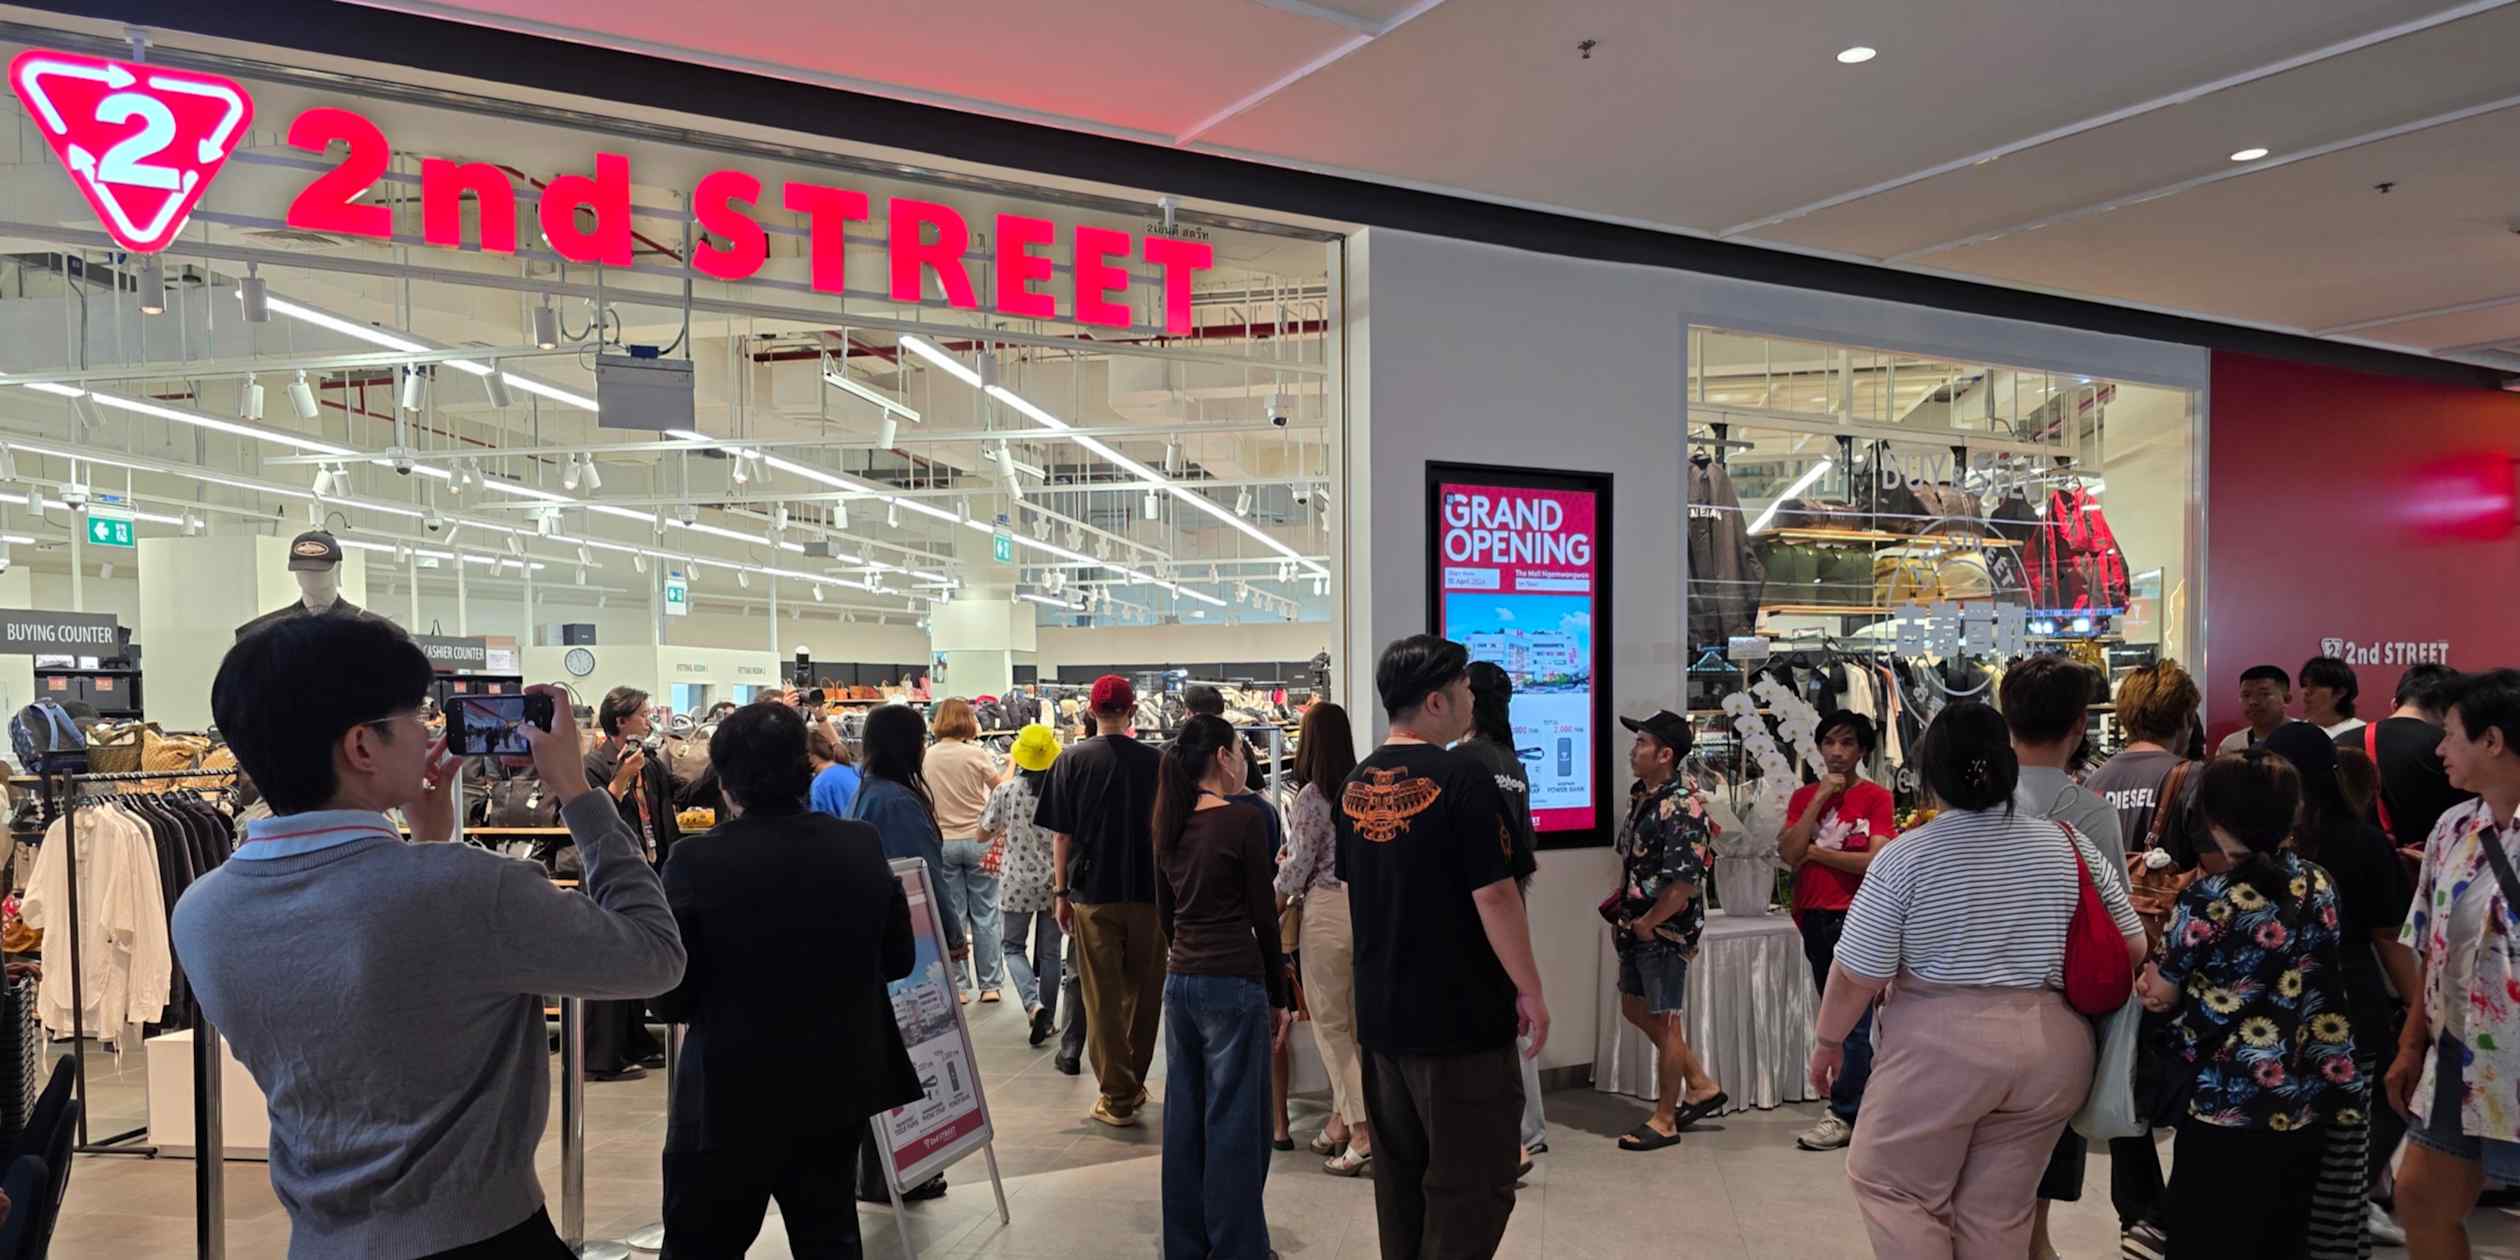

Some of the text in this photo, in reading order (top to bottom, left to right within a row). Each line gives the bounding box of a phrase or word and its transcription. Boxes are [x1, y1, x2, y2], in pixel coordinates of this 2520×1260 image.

[95, 92, 181, 191] 2
[287, 106, 1214, 336] 2nd STREET
[1445, 493, 1563, 532] GRAND
[1445, 528, 1590, 566] OPENING
[7, 623, 113, 643] BUYING COUNTER
[423, 644, 484, 660] CASHIER COUNTER
[2345, 641, 2449, 665] 2nd STREET
[2105, 788, 2157, 810] DIESEL
